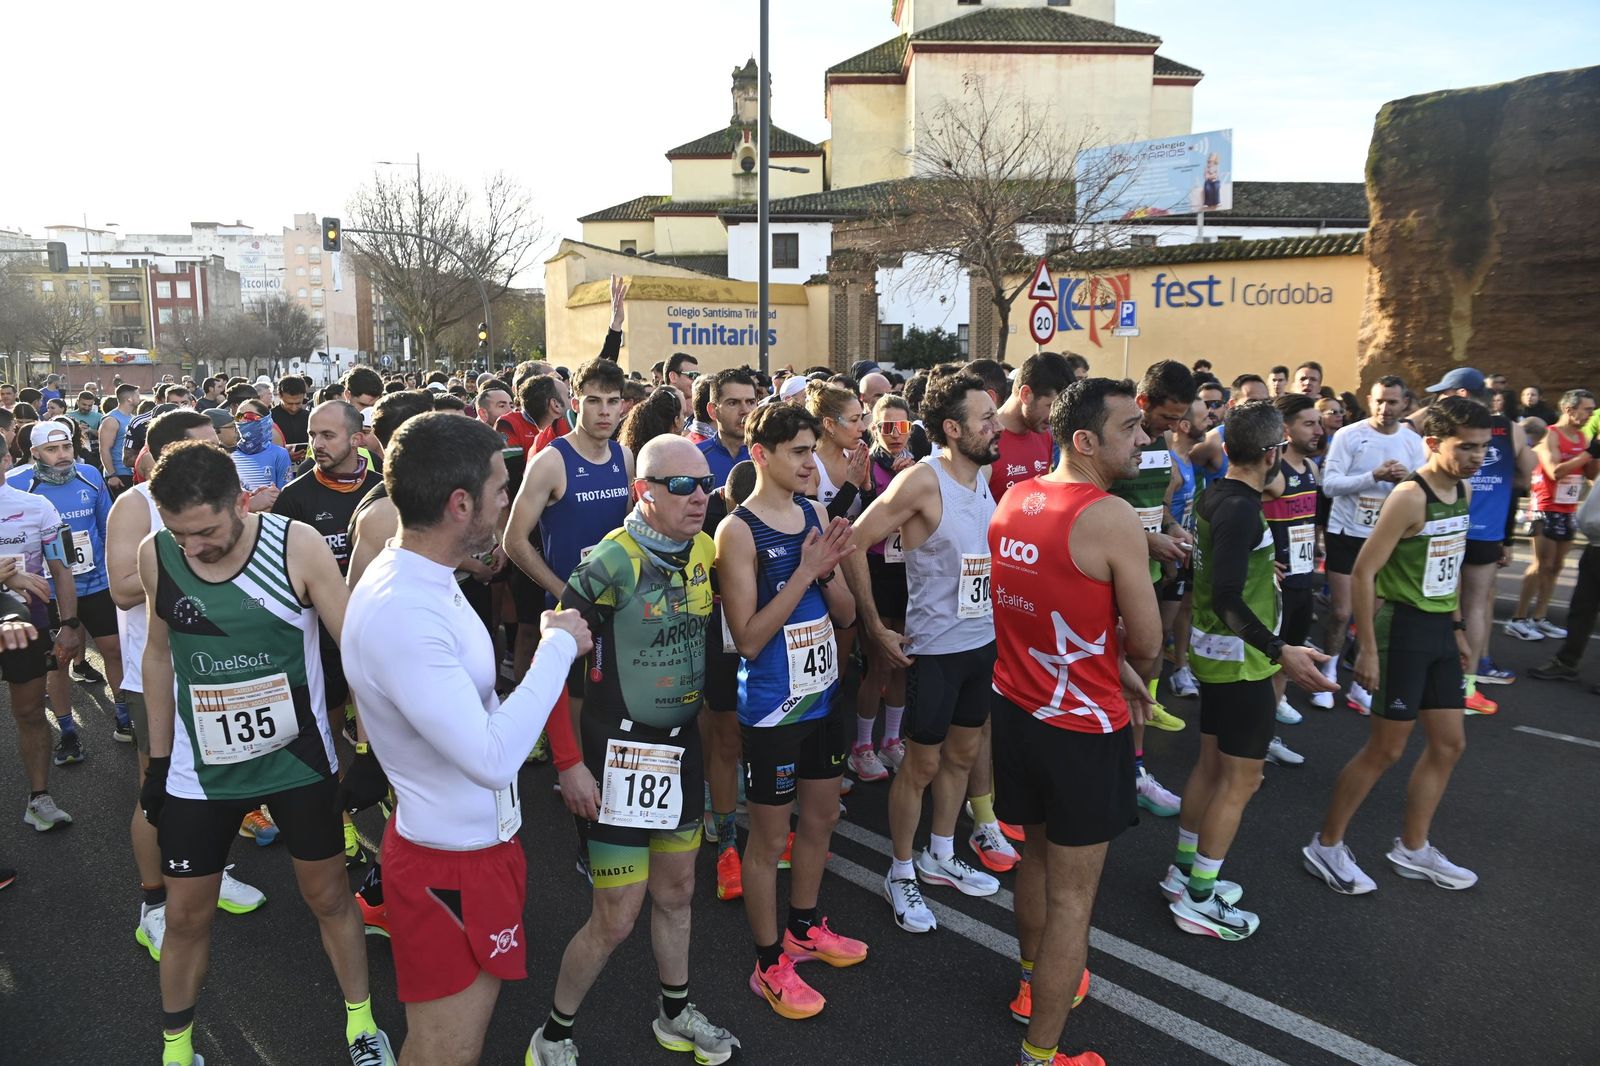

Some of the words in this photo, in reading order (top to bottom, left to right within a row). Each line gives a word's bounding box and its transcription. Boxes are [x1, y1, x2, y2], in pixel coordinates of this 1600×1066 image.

[1148, 140, 1186, 151] Colegio
[1151, 273, 1224, 308] fest
[1243, 282, 1333, 306] Córdoba
[667, 306, 701, 319] Colegio
[702, 307, 743, 319] Santísima
[1036, 316, 1051, 330] 20
[1000, 537, 1039, 564] UCO
[971, 576, 992, 603] 30
[1003, 594, 1034, 612] califas
[789, 626, 813, 649] XLII
[632, 656, 688, 667] Posadas
[804, 641, 833, 677] 430
[194, 690, 226, 712] XLII
[216, 706, 276, 745] 135
[625, 773, 672, 809] 182
